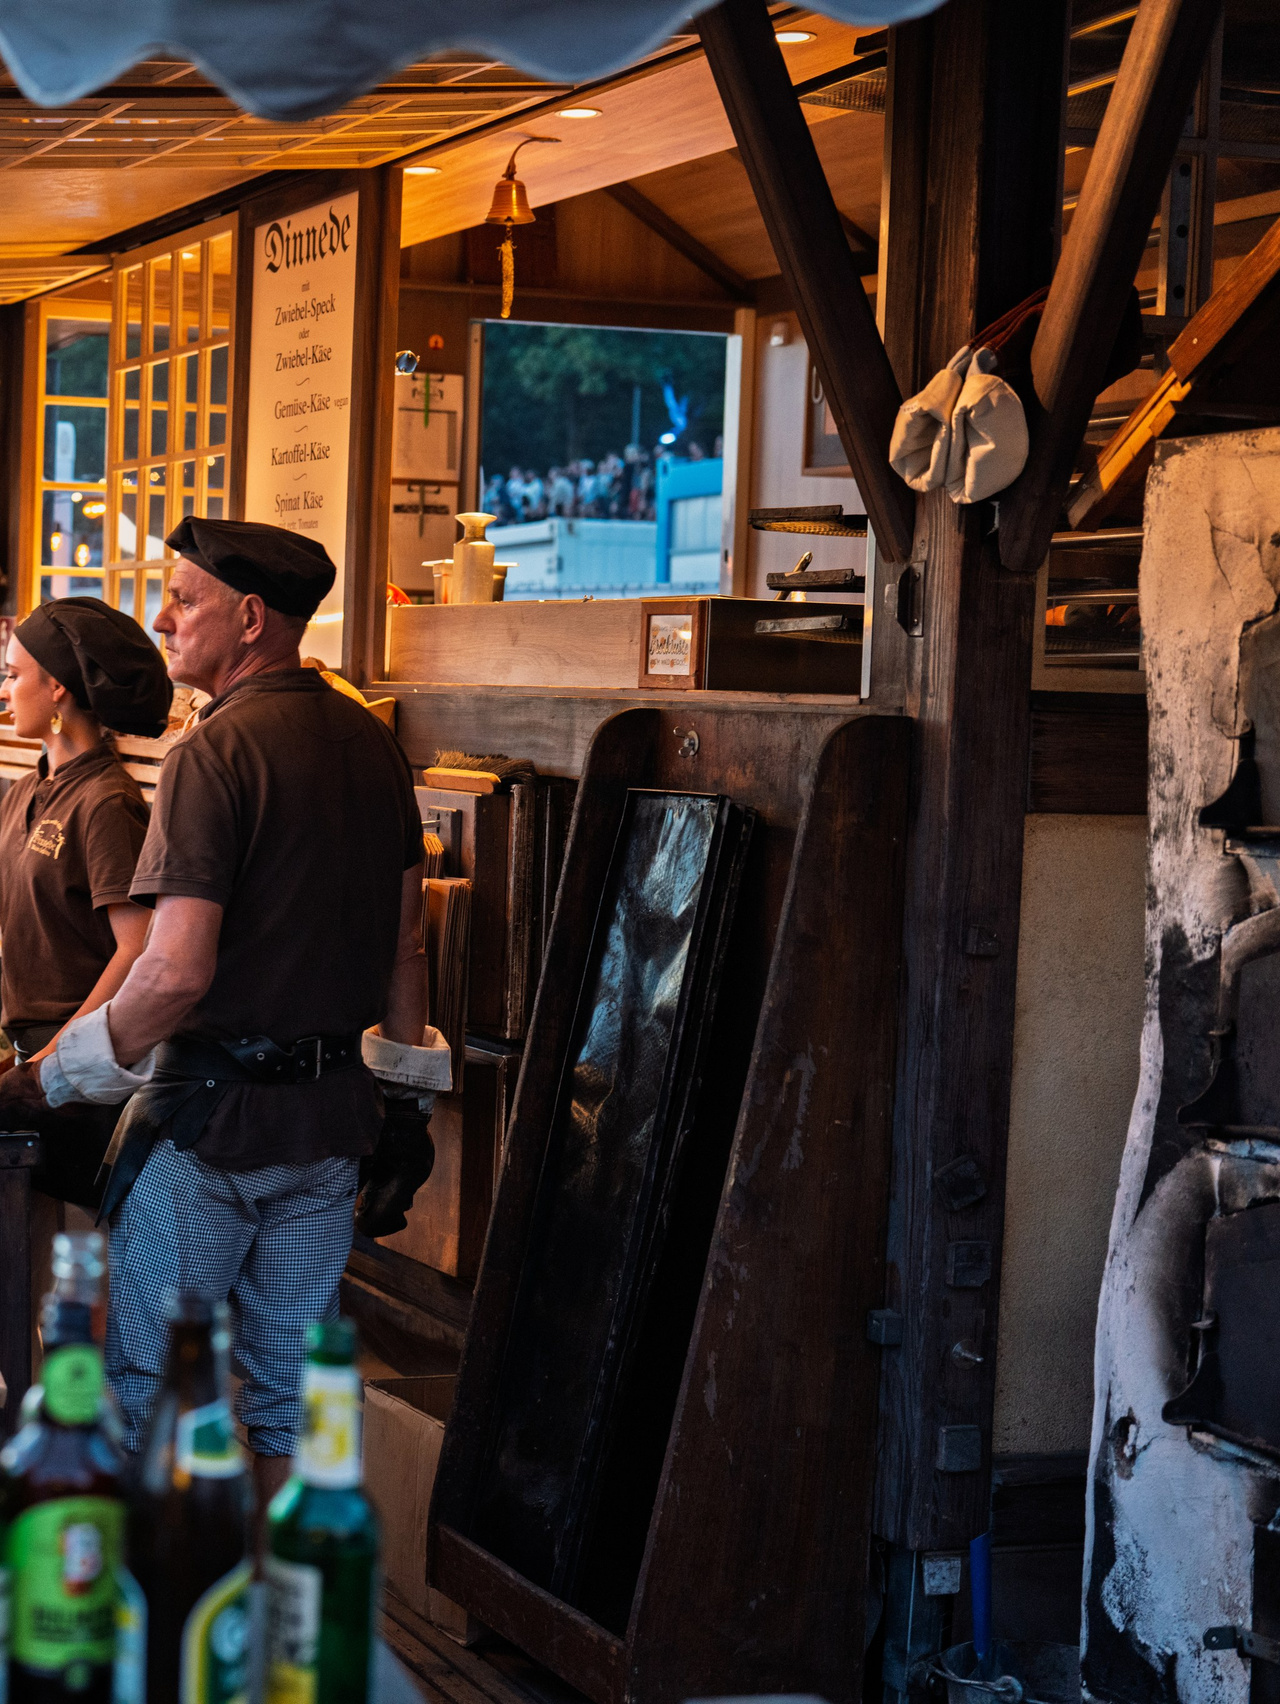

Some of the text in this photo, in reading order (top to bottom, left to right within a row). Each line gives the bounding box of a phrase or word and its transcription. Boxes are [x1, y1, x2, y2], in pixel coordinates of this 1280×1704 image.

[264, 205, 350, 273] Dinnede
[275, 293, 336, 326] Zwiebel-Speck
[298, 328, 310, 340] oder
[275, 345, 332, 372] Zwiebel-Käse
[274, 393, 331, 420] Gemüse-Käse
[271, 442, 331, 466] Kartoffel-Käse
[275, 491, 324, 517] Spinat Käse
